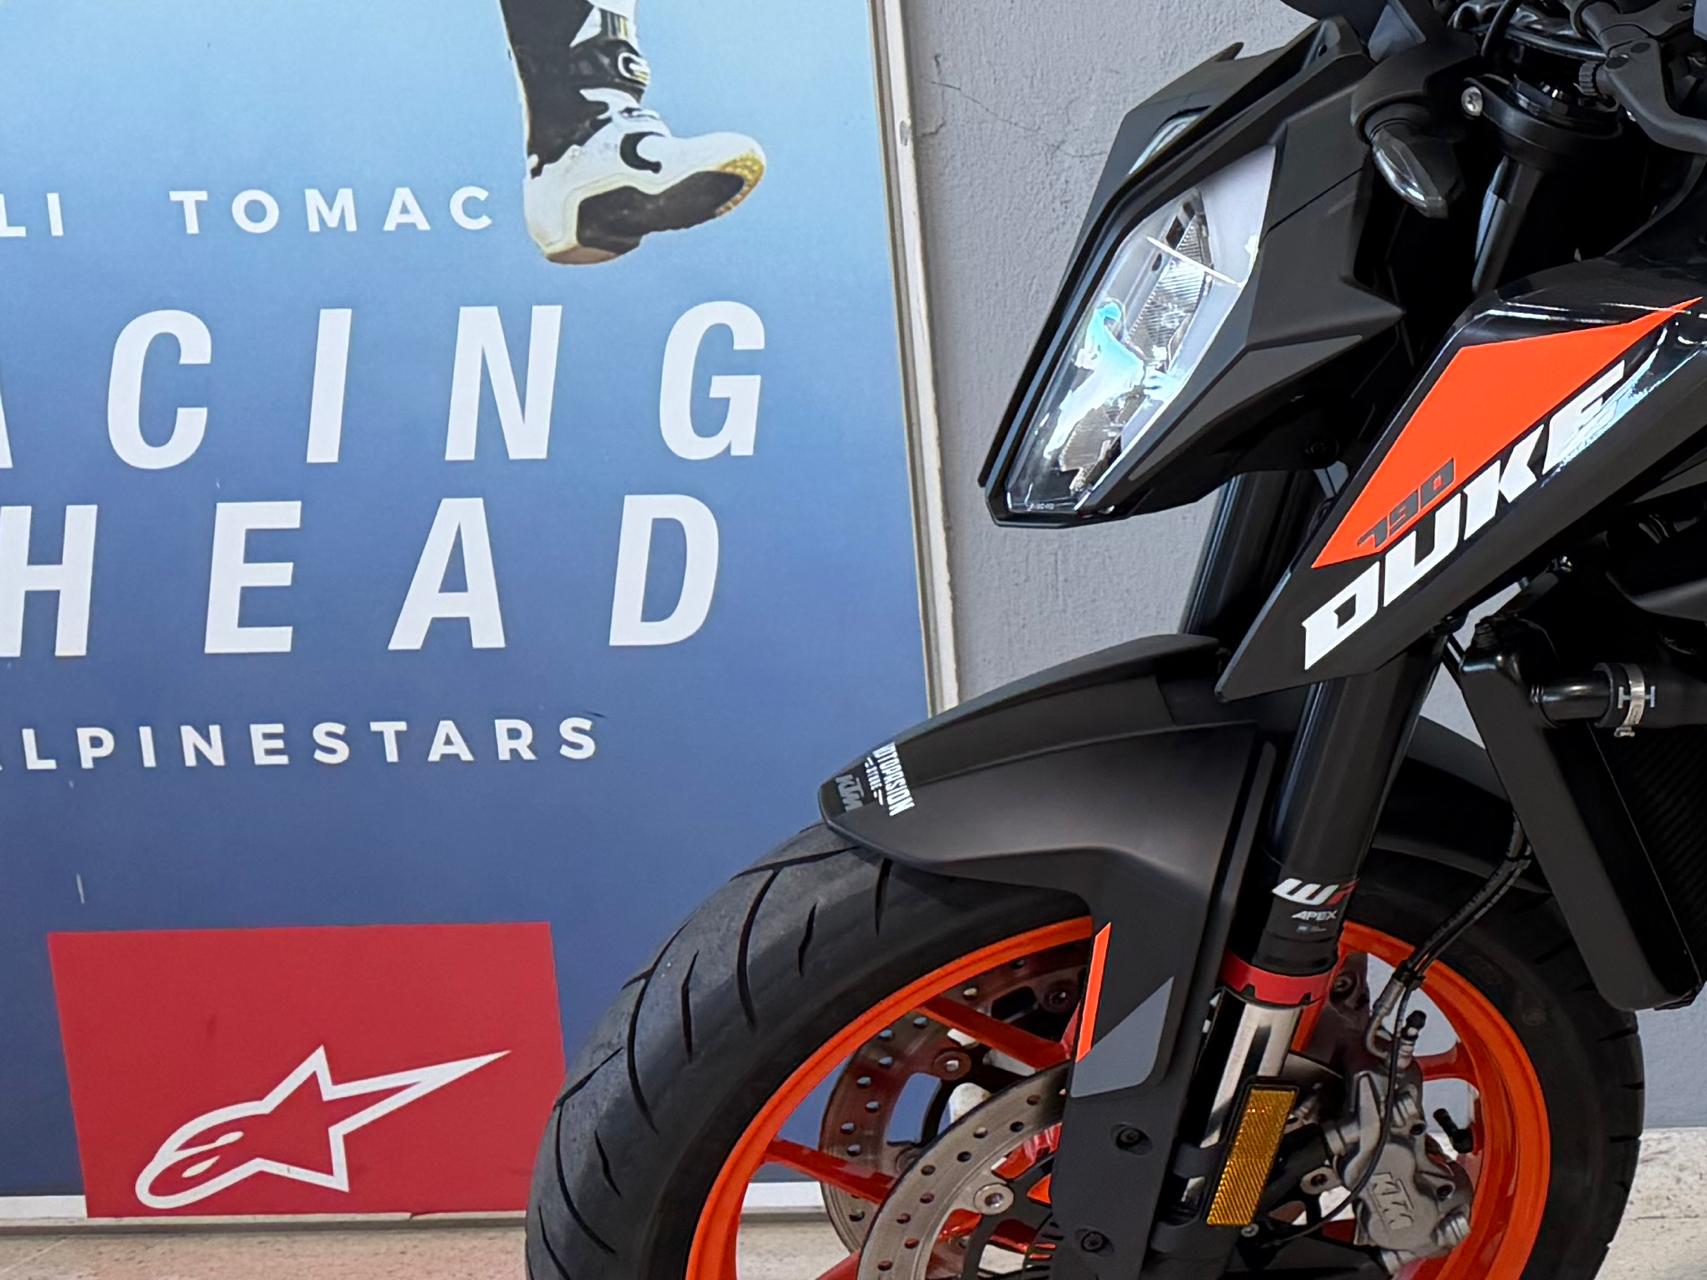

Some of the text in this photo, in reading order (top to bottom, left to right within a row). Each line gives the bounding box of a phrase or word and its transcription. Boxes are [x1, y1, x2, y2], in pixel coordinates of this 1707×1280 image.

[169, 185, 494, 236] TOMAC
[0, 300, 766, 470] CING
[1303, 359, 1640, 670] DUKE
[1357, 457, 1456, 549] 790
[0, 493, 722, 658] HEAD
[0, 716, 598, 772] LPINESTARS
[872, 741, 915, 817] OTOPASION
[836, 774, 865, 812] KTM
[1292, 910, 1338, 921] APEX
